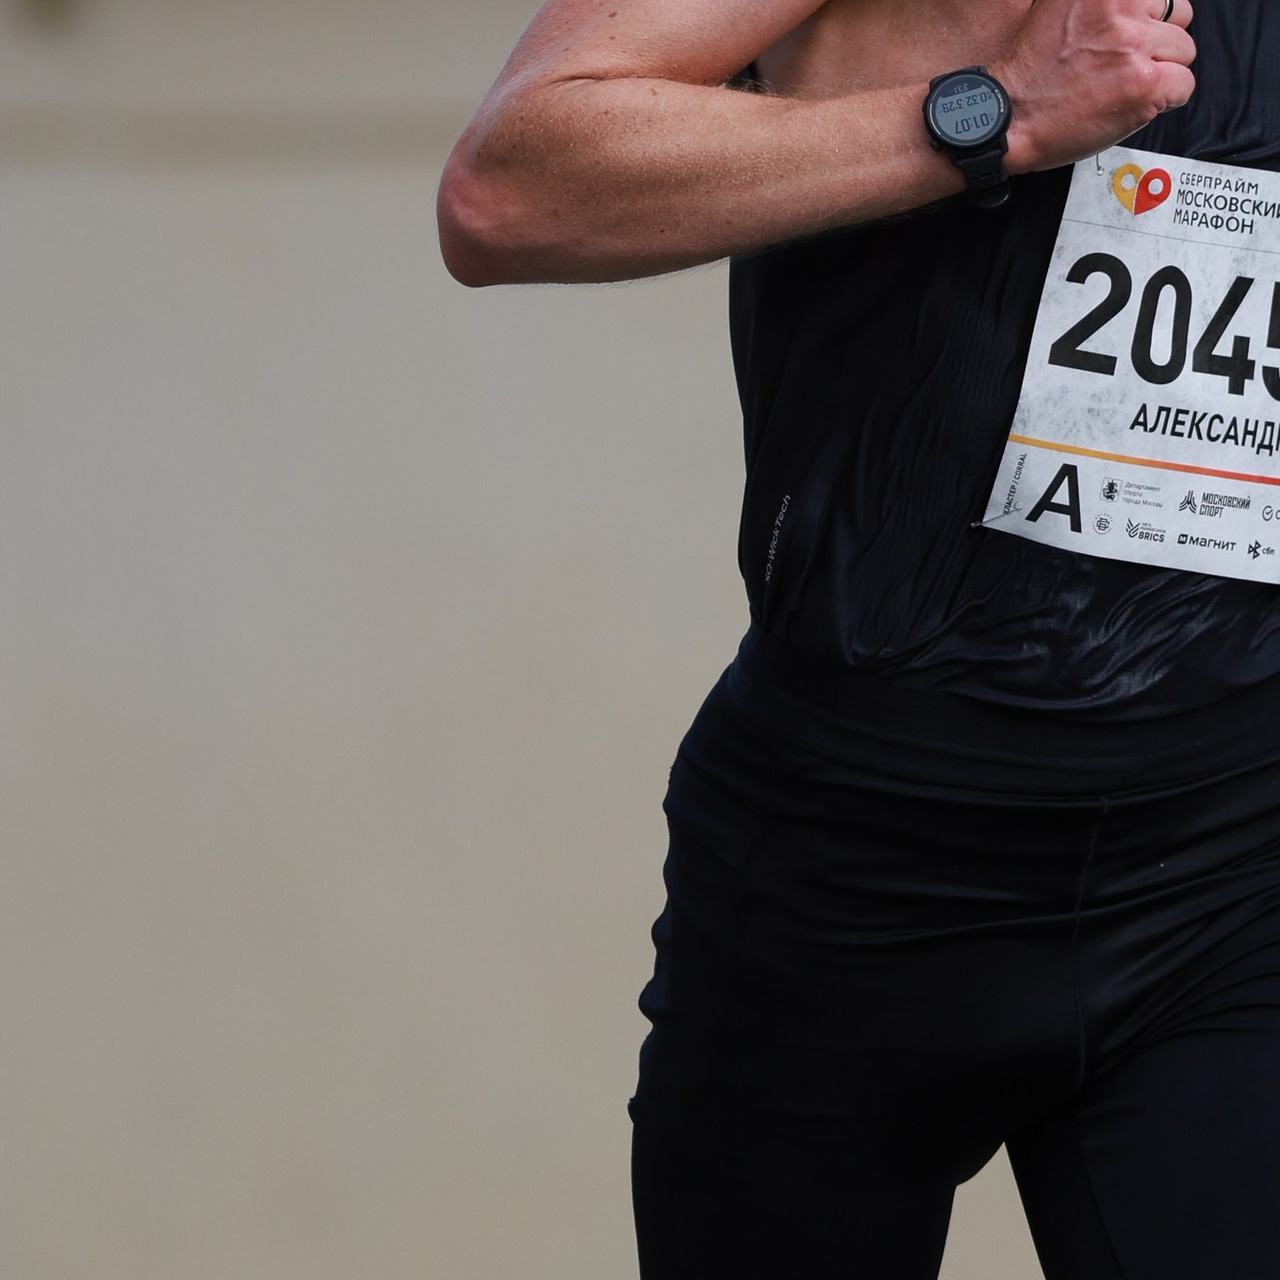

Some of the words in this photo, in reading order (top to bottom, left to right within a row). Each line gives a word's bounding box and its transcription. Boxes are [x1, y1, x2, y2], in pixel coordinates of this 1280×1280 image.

[955, 113, 990, 135] 01:07
[1180, 172, 1259, 195] СБЕРПРАЙМ
[1173, 208, 1254, 234] МАРАФОН
[1013, 453, 1028, 480] CORRAL
[1201, 492, 1251, 510] МОСКОВСКИЙ
[1198, 504, 1224, 518] СПОРТ
[1138, 531, 1165, 543] BRICS
[1189, 536, 1237, 551] магнит
[1261, 546, 1275, 556] сбп
